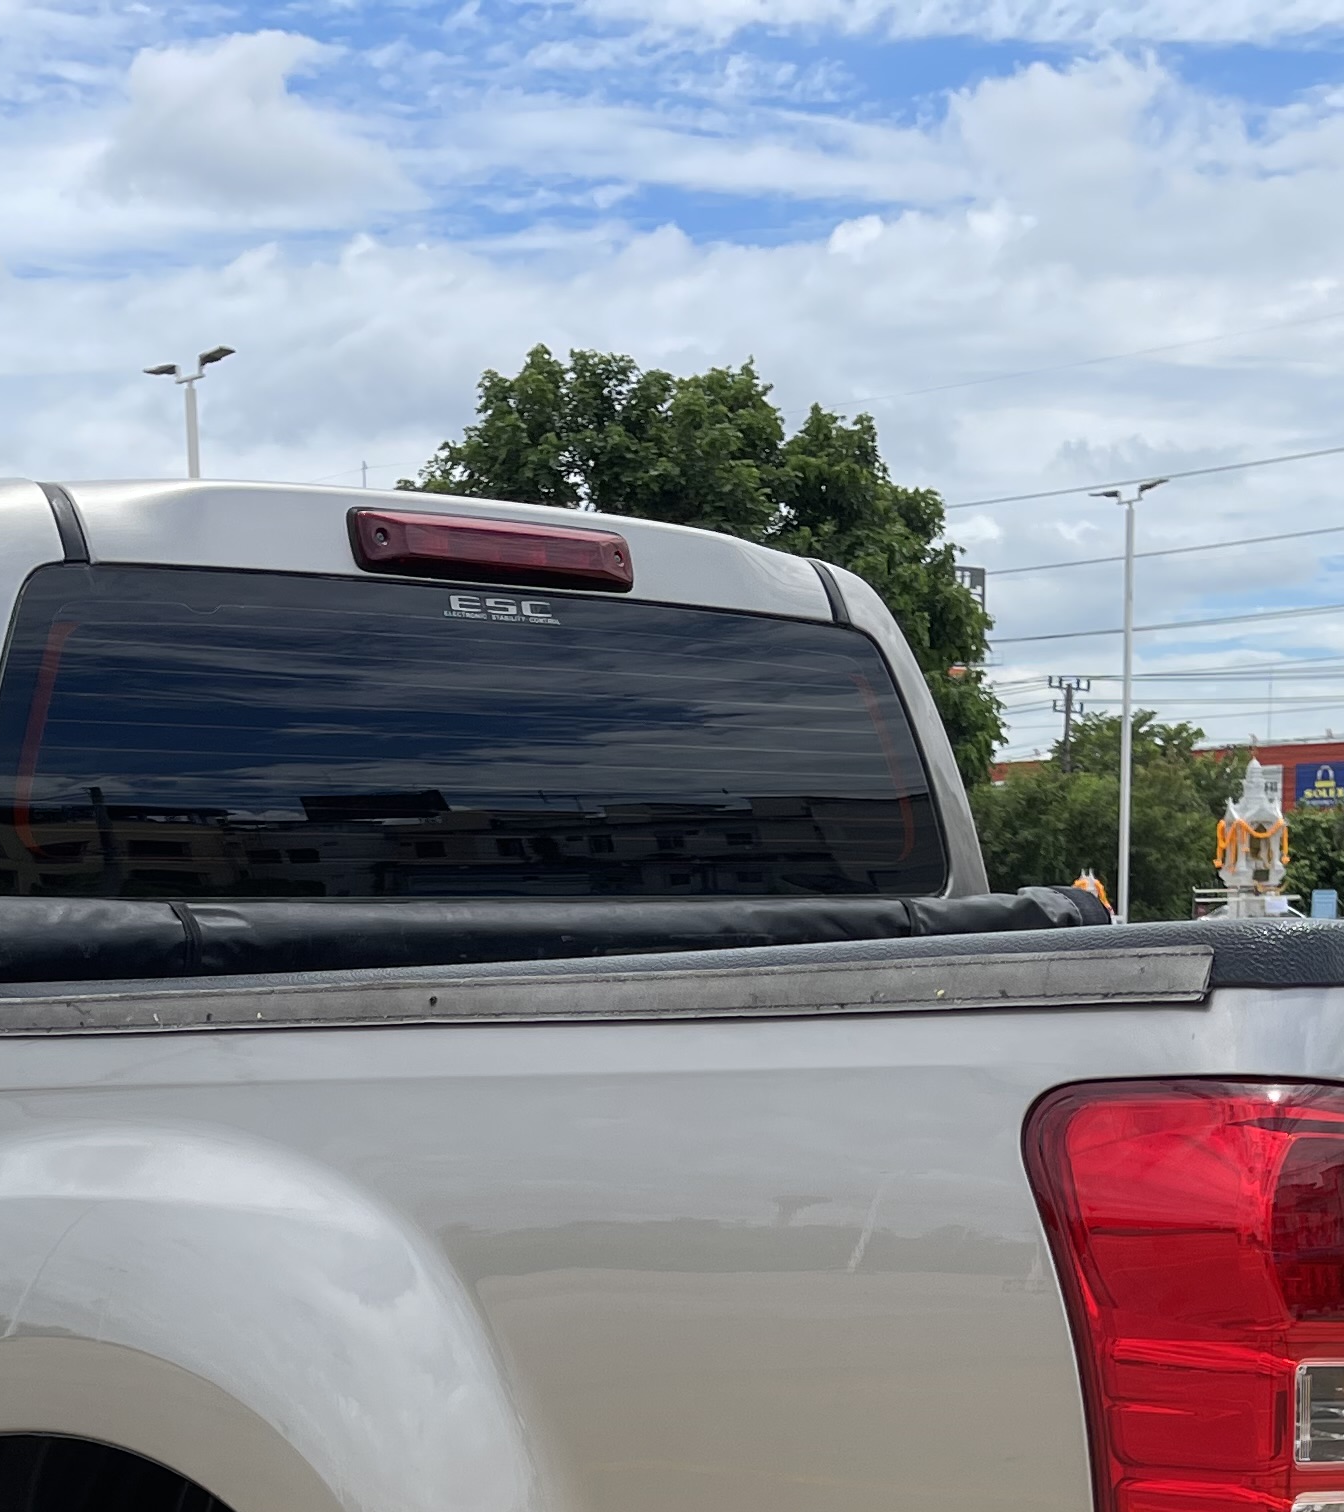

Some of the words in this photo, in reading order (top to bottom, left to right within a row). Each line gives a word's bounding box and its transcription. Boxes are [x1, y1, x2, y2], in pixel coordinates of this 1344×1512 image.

[449, 595, 552, 617] ESC
[443, 610, 487, 620] ELECTRONIC
[492, 614, 526, 622] STABILITY
[529, 617, 561, 625] CONTROL
